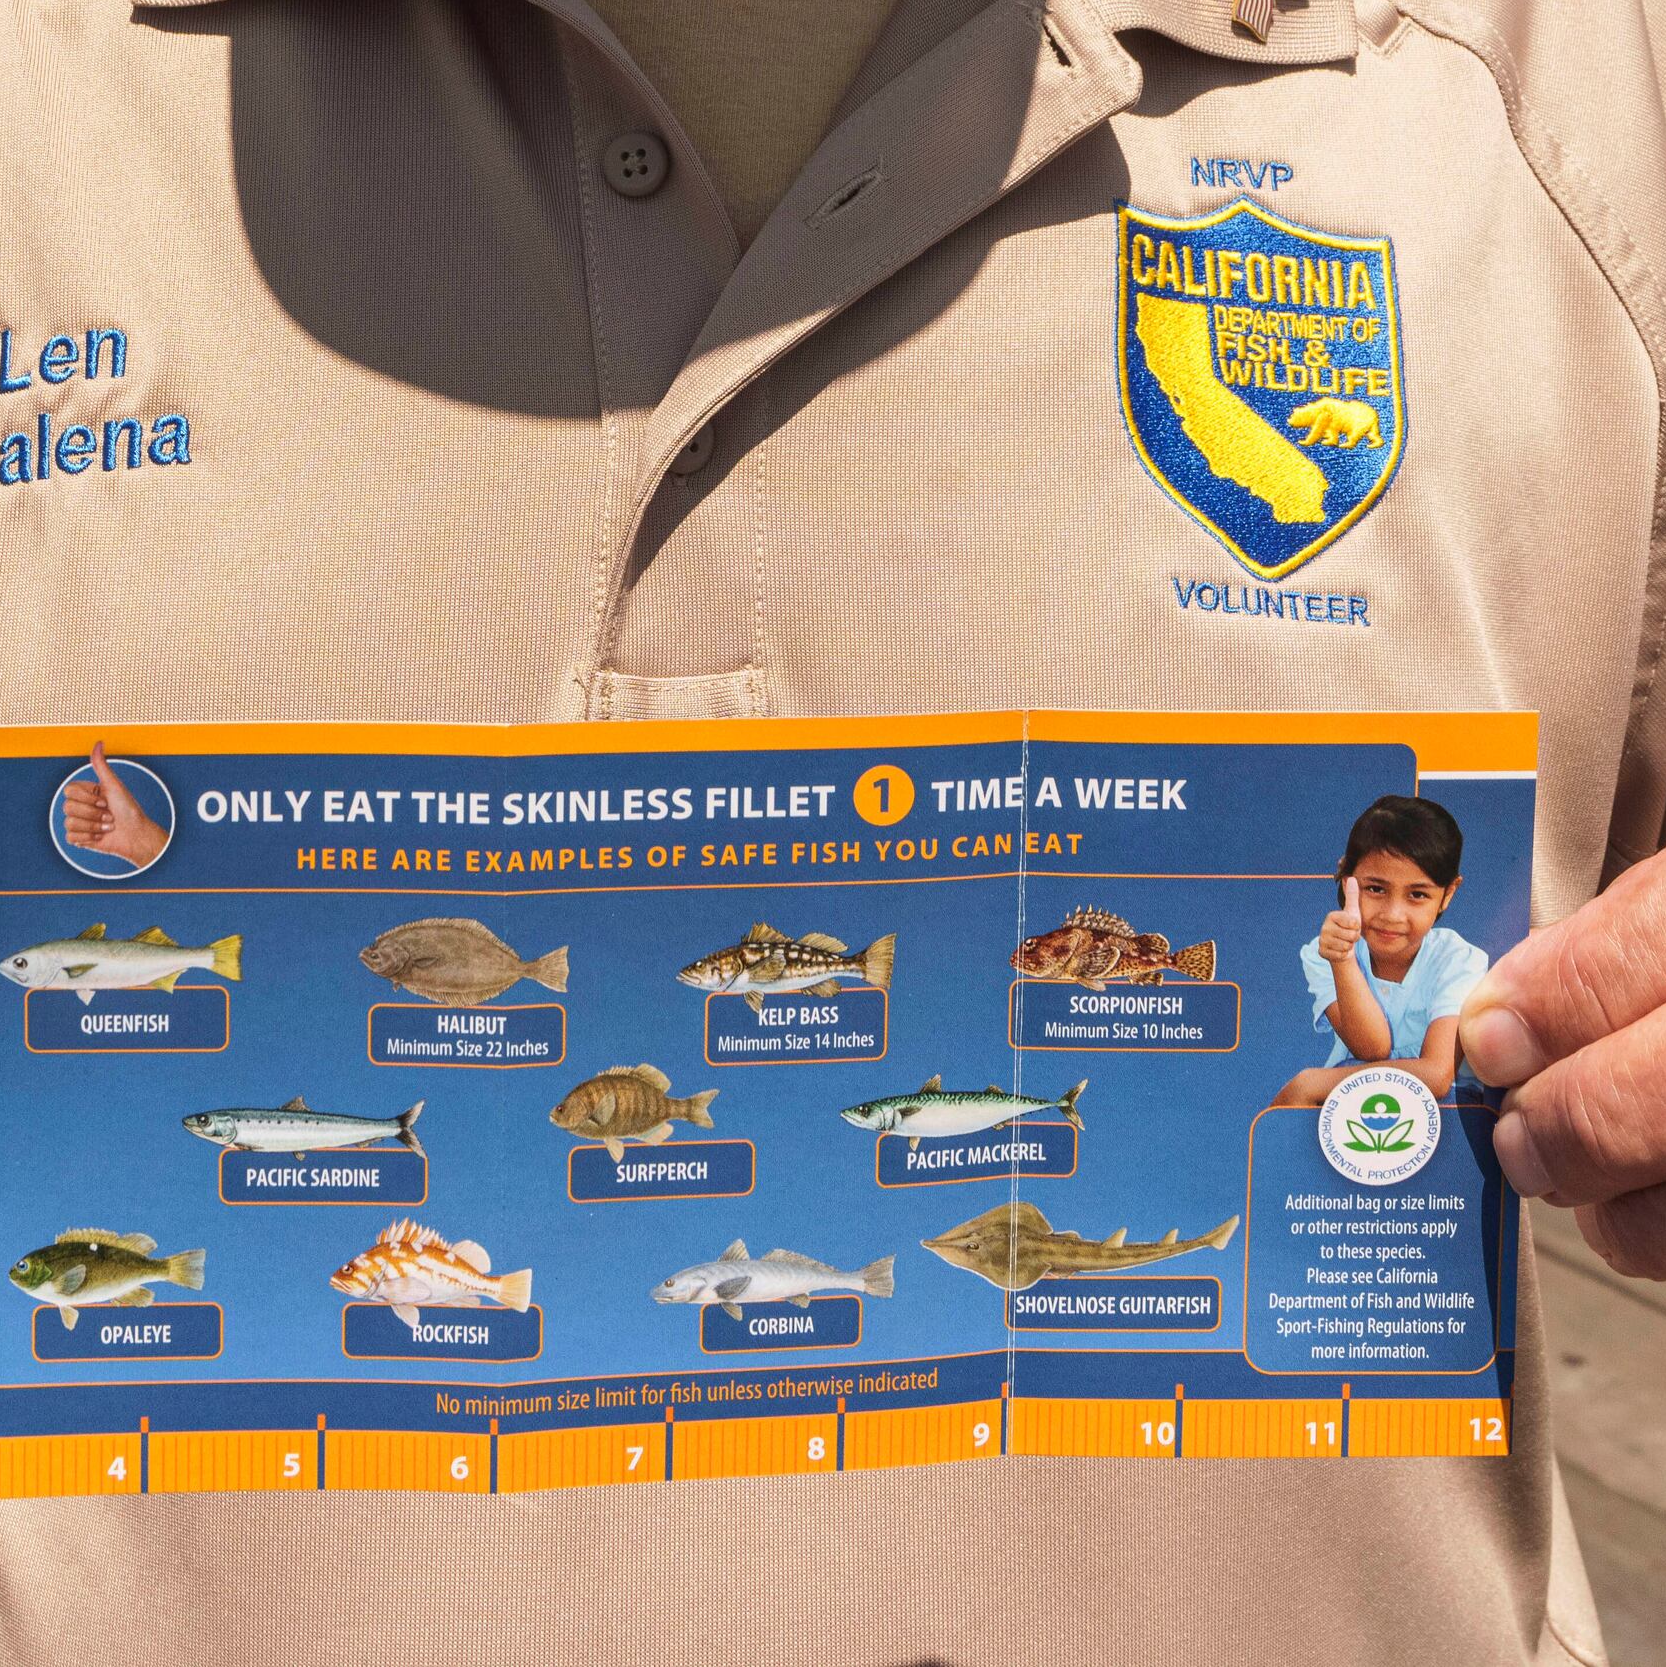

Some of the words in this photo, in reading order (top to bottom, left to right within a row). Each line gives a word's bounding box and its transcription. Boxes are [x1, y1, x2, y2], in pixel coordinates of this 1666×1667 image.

[1191, 157, 1293, 191] NRVP
[1133, 234, 1376, 310] CALIFORNIA
[1215, 306, 1351, 341] DEPARTMENT
[1353, 317, 1380, 342] OF
[1218, 335, 1290, 365] FISH
[1304, 340, 1331, 368] &
[1221, 361, 1390, 396] WILDLIFE
[1172, 577, 1371, 627] VOLUNTEER
[197, 790, 312, 823] ONLY
[323, 790, 401, 823] EAT
[411, 791, 490, 825] THE
[502, 787, 693, 825] SKINLESS
[706, 785, 836, 819] FILLET
[873, 778, 891, 813] 1
[931, 778, 1023, 813] TIME
[1034, 776, 1063, 808] A
[1074, 777, 1187, 810] WEEK
[297, 848, 377, 870] HERE
[391, 849, 451, 871] ARE
[466, 846, 633, 873] EXAMPLES
[646, 845, 687, 868] OF
[700, 843, 777, 867] SAFE
[791, 841, 860, 864] FISH
[875, 838, 938, 862] YOU
[951, 833, 1012, 858] CAN
[1024, 832, 1083, 855] EAT
[758, 1007, 797, 1026] KELP
[800, 1005, 839, 1025] BASS
[1069, 995, 1183, 1015] SCORPIONFISH
[80, 1014, 169, 1035] QUEENFISH
[437, 1015, 507, 1035] HALIBUT
[1045, 1021, 1109, 1039] Minimum
[1112, 1022, 1139, 1039] Size
[1142, 1023, 1158, 1039] 10
[1161, 1023, 1203, 1040] Inches
[387, 1038, 453, 1056] Minimum
[456, 1039, 483, 1057] Size
[485, 1041, 503, 1058] 22
[506, 1039, 549, 1057] Inches
[718, 1035, 782, 1052] Minimum
[785, 1033, 811, 1050] Size
[814, 1033, 831, 1049] 14
[833, 1031, 875, 1048] Inches
[1341, 1072, 1381, 1095] UNITED
[1384, 1073, 1423, 1095] STATES
[1321, 1100, 1363, 1178] ENVIRONMENTAL
[1368, 1145, 1431, 1180] PROTECTION
[1423, 1098, 1438, 1142] AGENCY
[907, 1148, 965, 1170] PACIFIC
[967, 1143, 1047, 1165] MACKEREL
[246, 1168, 307, 1187] PACIFIC
[310, 1168, 380, 1187] SARDINE
[616, 1161, 708, 1183] SURFPERCH
[1285, 1194, 1353, 1210] Additional
[1356, 1193, 1381, 1214] bag
[1384, 1198, 1398, 1210] or
[1400, 1194, 1426, 1210] size
[1428, 1193, 1465, 1210] limits
[1290, 1222, 1305, 1235] or
[1307, 1218, 1343, 1235] other
[1346, 1220, 1418, 1235] restrictions
[1421, 1218, 1458, 1239] apply
[1320, 1245, 1334, 1259] to
[1336, 1242, 1373, 1259] these
[1375, 1246, 1426, 1263] species.
[1306, 1267, 1349, 1284] Please
[1351, 1271, 1374, 1284] see
[1376, 1267, 1438, 1284] California
[1015, 1295, 1116, 1315] SHOVELNOSE
[1119, 1296, 1211, 1315] GUITARFISH
[1269, 1292, 1348, 1313] Department
[1350, 1292, 1366, 1309] of
[1367, 1292, 1393, 1309] Fish
[1395, 1292, 1421, 1309] and
[1424, 1292, 1475, 1309] Wildlife
[100, 1324, 172, 1345] OPALEYE
[412, 1324, 489, 1345] ROCKFISH
[748, 1316, 814, 1336] CORBINA
[1276, 1317, 1364, 1338] Sport-Fishing
[1367, 1317, 1445, 1338] Regulations
[1447, 1317, 1467, 1334] for
[1311, 1346, 1346, 1359] more
[1348, 1342, 1430, 1359] information.
[436, 1392, 461, 1415] No
[465, 1395, 552, 1416] minimum
[557, 1389, 591, 1411] size
[595, 1386, 637, 1408] limit
[640, 1383, 667, 1405] for
[669, 1381, 702, 1404] fish
[707, 1377, 762, 1402] unless
[765, 1372, 854, 1398] otherwise
[858, 1367, 938, 1394] indicated
[107, 1457, 126, 1480] 4
[283, 1453, 300, 1476] 5
[450, 1455, 469, 1479] 6
[626, 1446, 643, 1470] 7
[807, 1436, 825, 1460] 8
[972, 1422, 989, 1446] 9
[1140, 1422, 1174, 1445] 10
[1305, 1422, 1335, 1445] 11
[1469, 1418, 1502, 1441] 12
